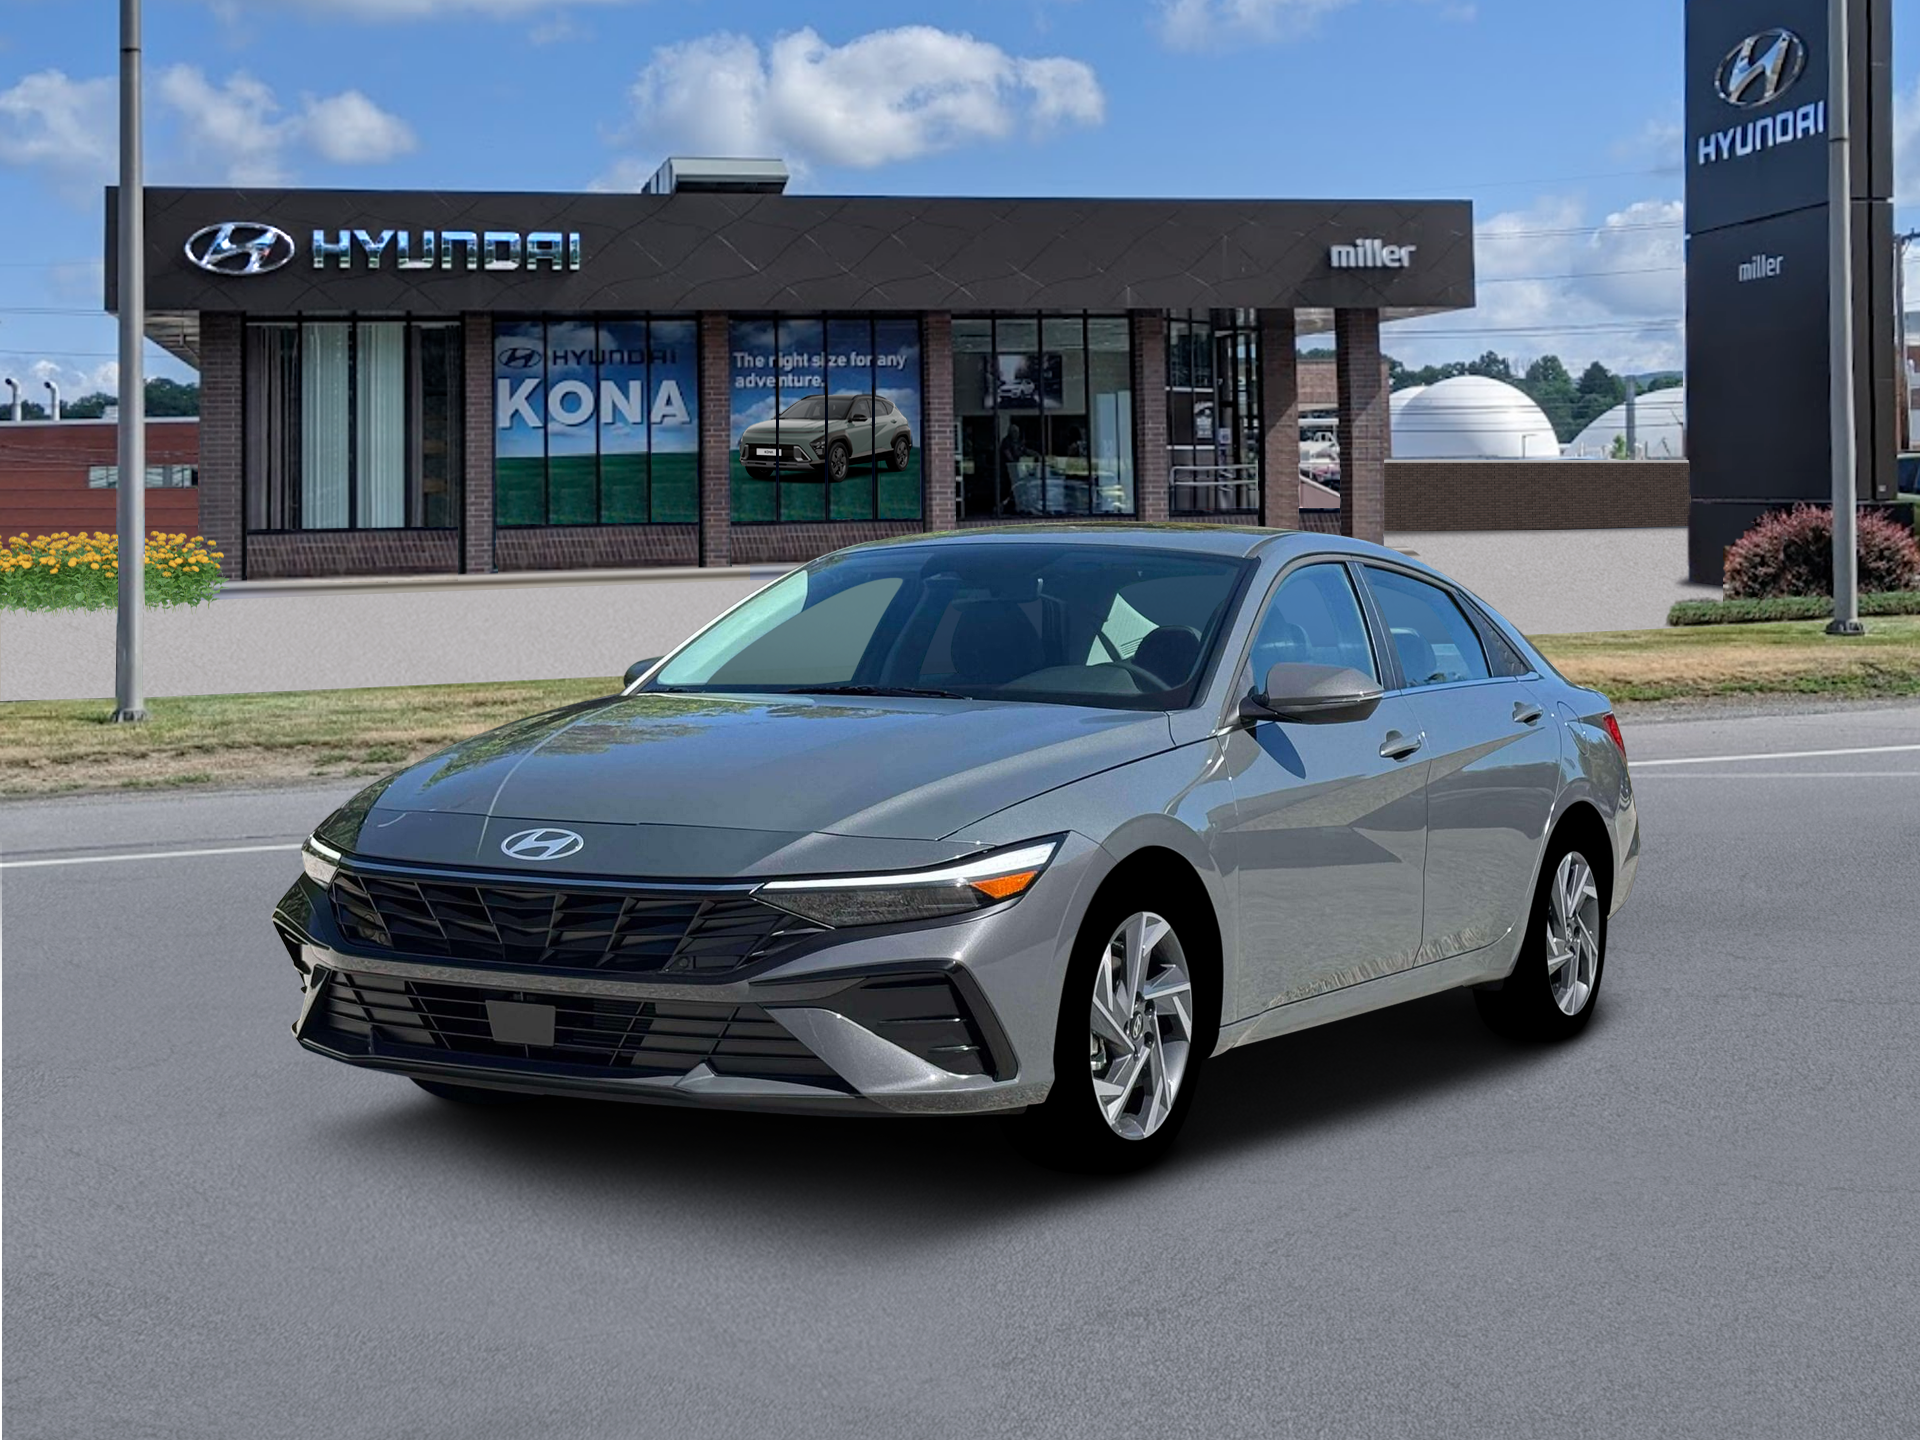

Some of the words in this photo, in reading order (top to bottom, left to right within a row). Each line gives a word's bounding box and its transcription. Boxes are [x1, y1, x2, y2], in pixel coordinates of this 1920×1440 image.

[1698, 100, 1824, 165] HYUNDAI
[312, 229, 580, 271] HYUNDAI
[1330, 238, 1417, 268] miller
[1738, 254, 1784, 282] miller
[552, 349, 677, 366] HYUNDAI
[733, 352, 765, 368] The
[768, 352, 809, 371] right
[811, 352, 847, 367] size
[850, 351, 873, 367] for
[877, 354, 907, 370] any
[734, 373, 826, 388] adventure.
[498, 378, 691, 429] KONA
